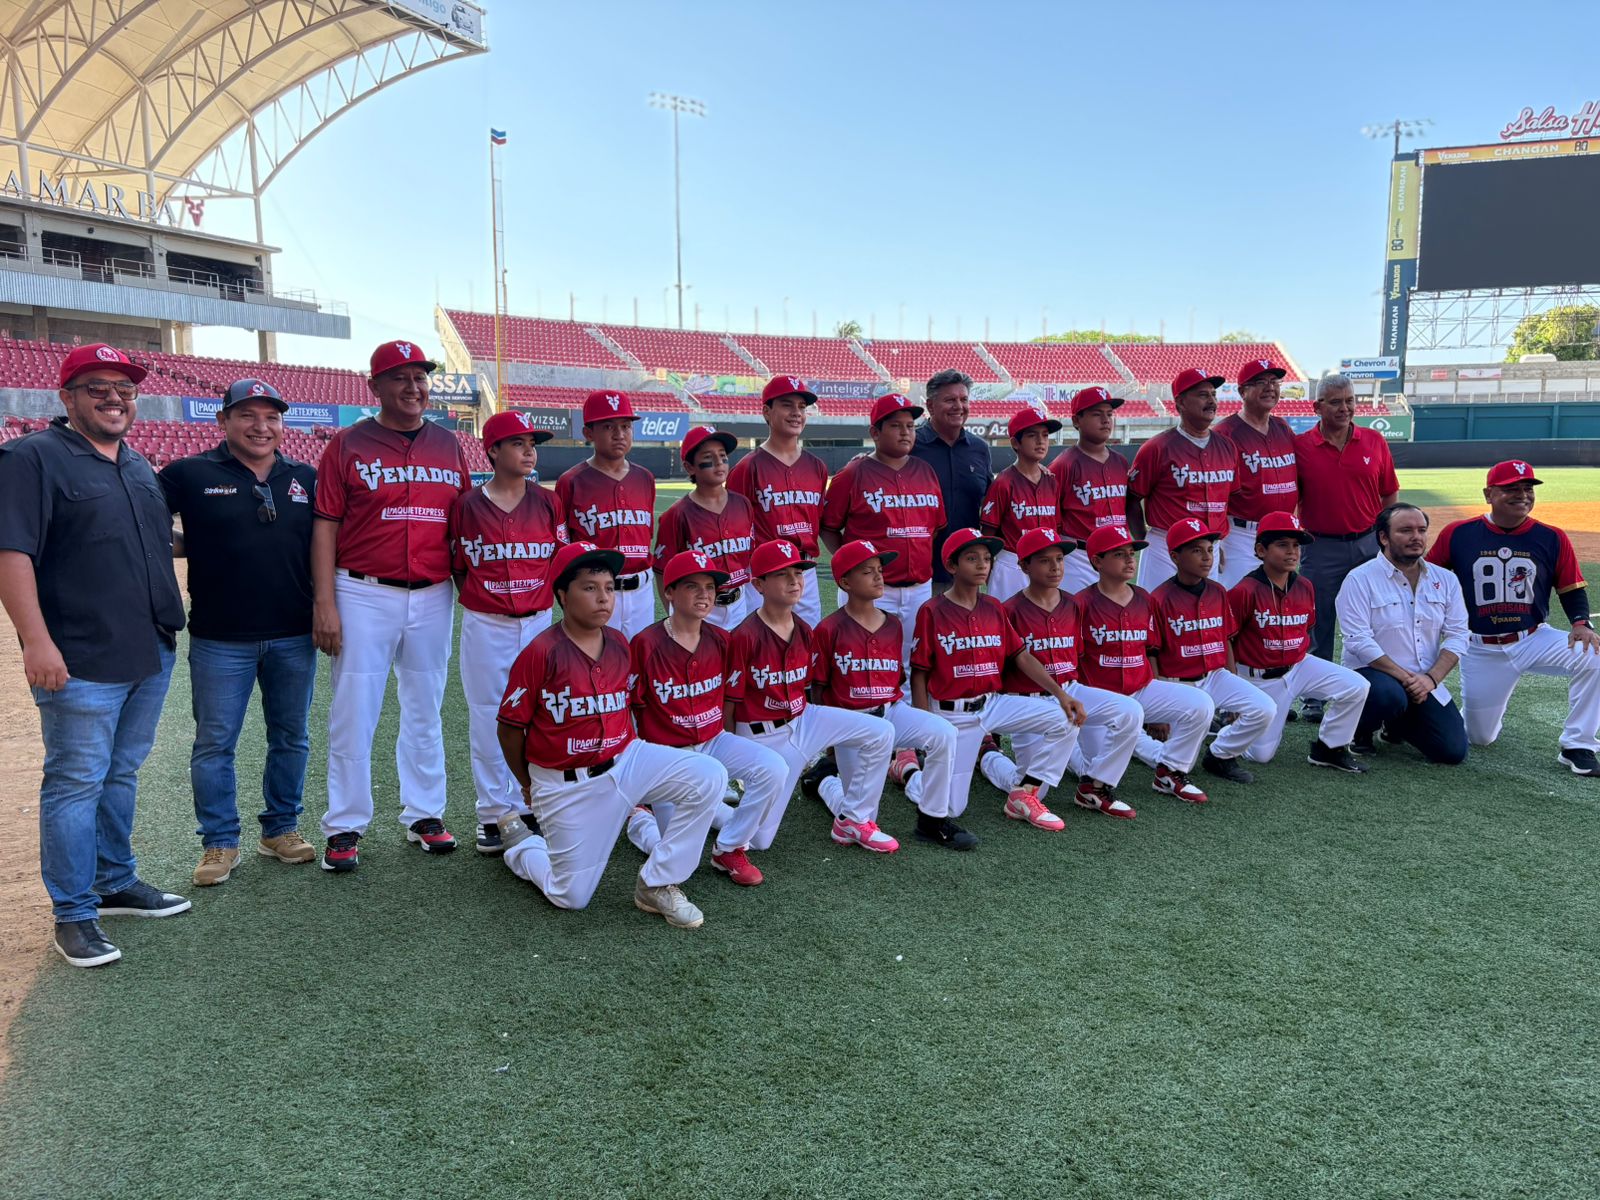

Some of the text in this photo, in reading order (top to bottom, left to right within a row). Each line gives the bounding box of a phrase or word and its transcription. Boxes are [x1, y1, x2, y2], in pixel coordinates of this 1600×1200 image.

[1500, 99, 1600, 140] Salsa H
[1390, 306, 1399, 351] CHANGAN
[822, 383, 870, 396] inteligis
[531, 415, 568, 426] VIZSLA
[641, 416, 681, 436] telcel
[355, 457, 462, 491] VENADOS
[1242, 450, 1296, 474] VENADO
[1171, 463, 1235, 488] VENADO
[755, 484, 822, 513] VENADO
[1089, 624, 1148, 646] VENADO
[1167, 614, 1224, 637] VENADO
[937, 631, 1002, 656] VENADOS
